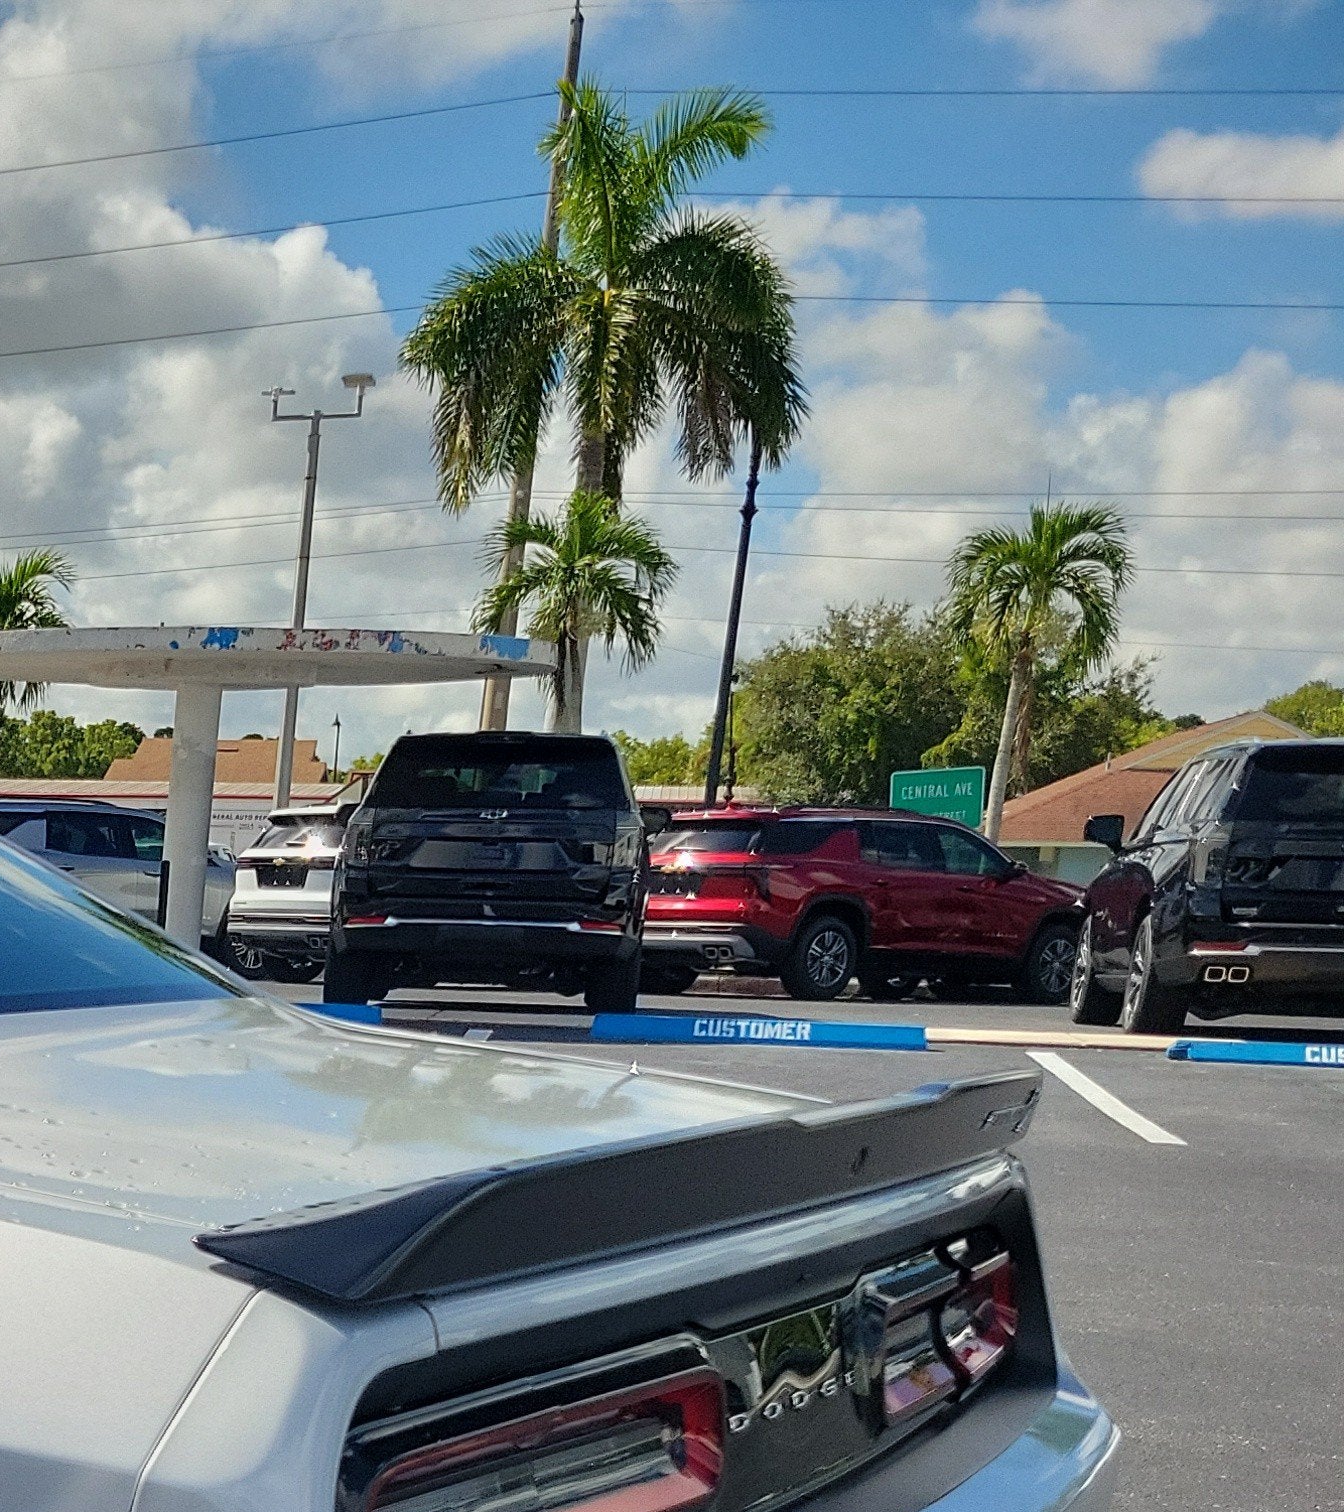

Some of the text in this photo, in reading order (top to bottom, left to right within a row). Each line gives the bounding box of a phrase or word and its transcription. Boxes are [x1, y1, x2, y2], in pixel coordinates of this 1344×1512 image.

[901, 782, 972, 800] CENTRAL AVE
[692, 1018, 811, 1040] CUSTOMER
[728, 1370, 857, 1434] DODGE
